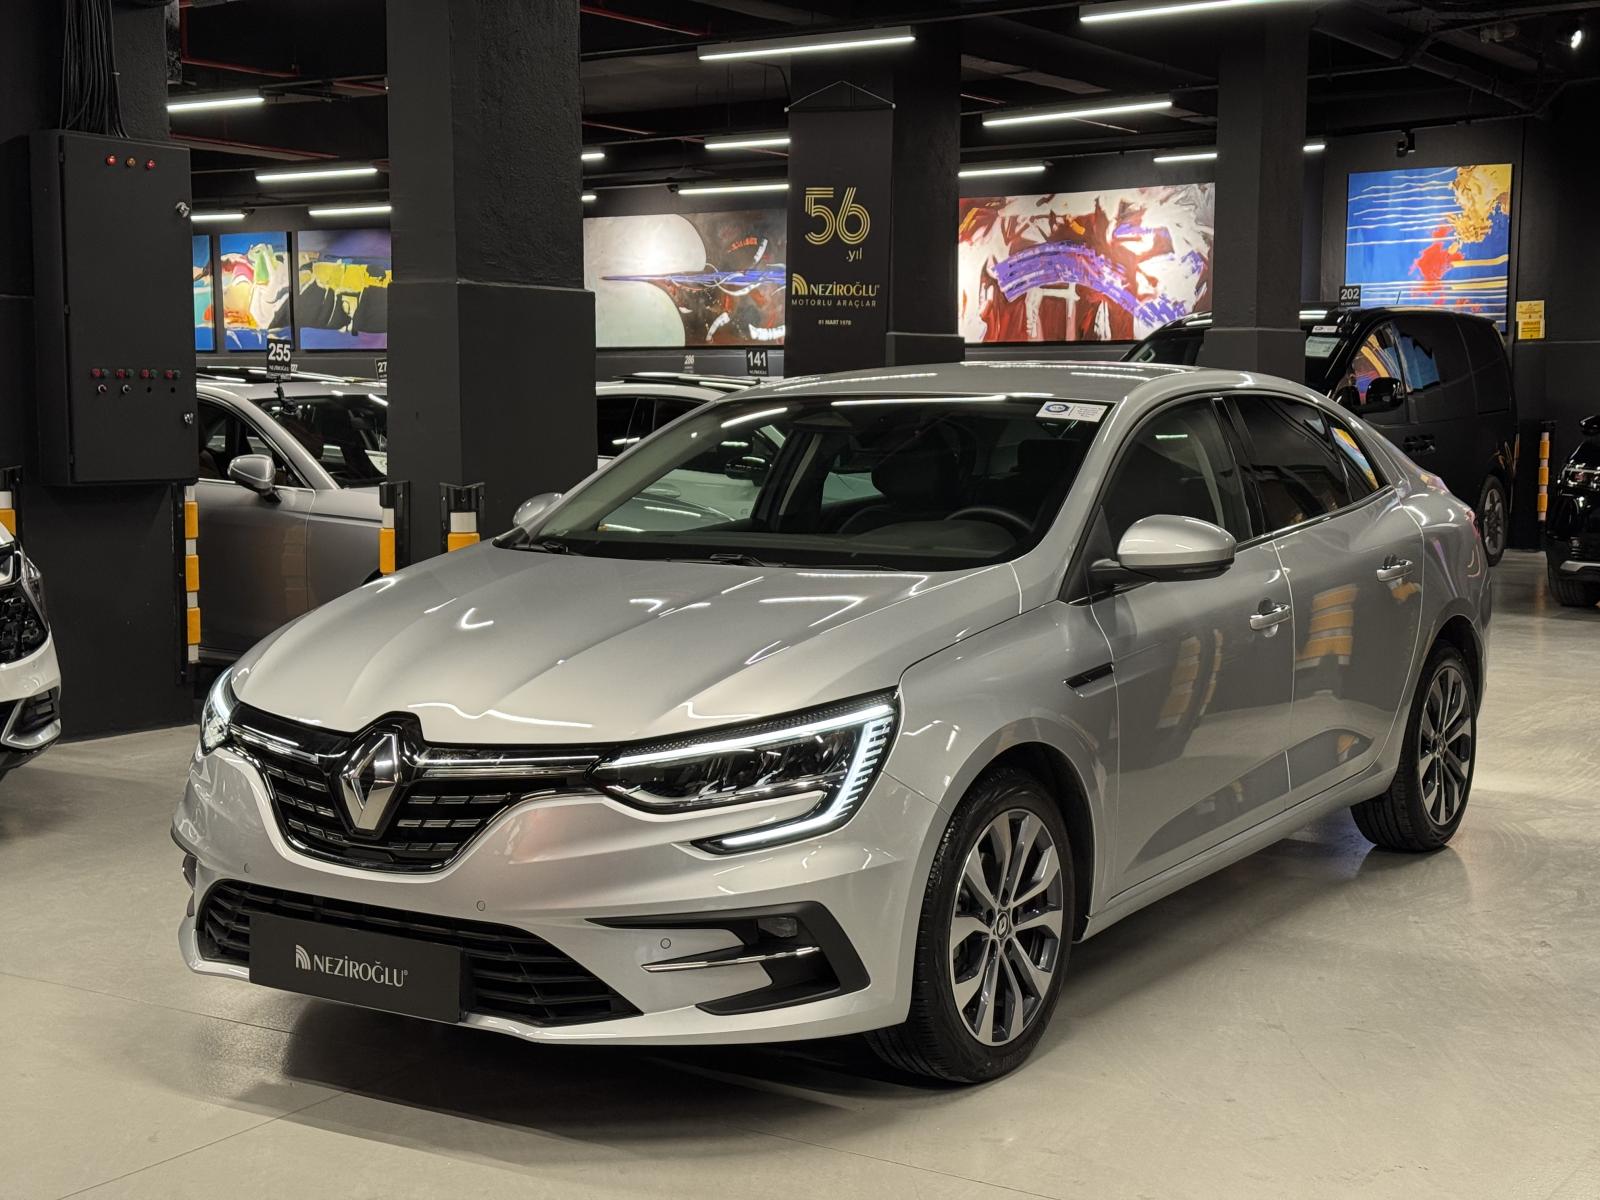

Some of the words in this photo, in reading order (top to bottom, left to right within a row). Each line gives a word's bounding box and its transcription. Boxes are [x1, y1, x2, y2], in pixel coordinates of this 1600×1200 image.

[805, 187, 870, 245] 56
[1341, 288, 1360, 300] 202
[837, 299, 877, 309] ARAÇLAR
[268, 342, 291, 362] 255
[748, 351, 767, 367] 141
[378, 362, 387, 373] 27
